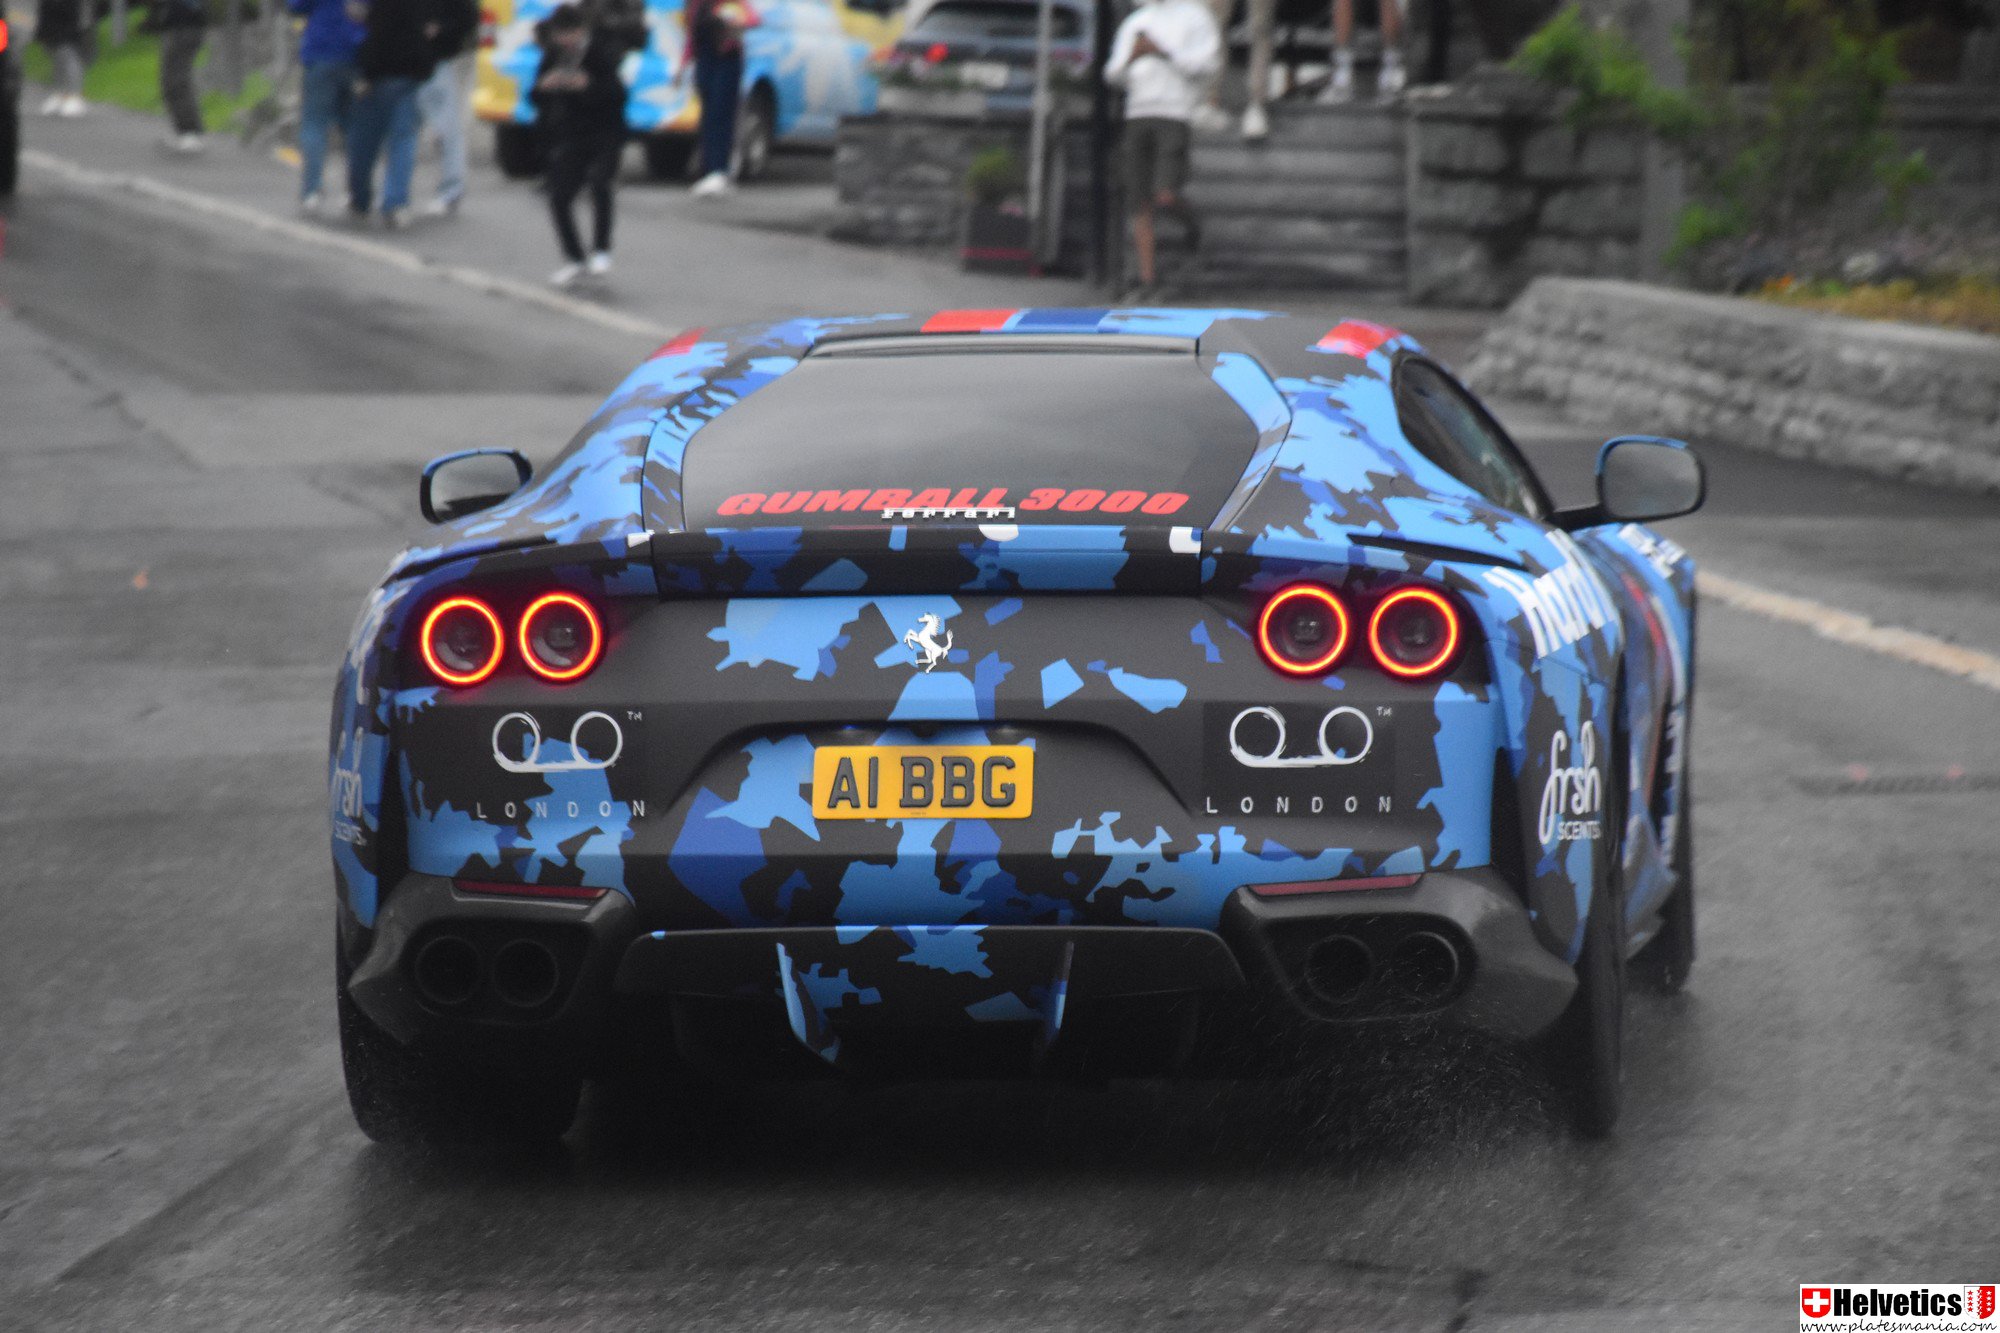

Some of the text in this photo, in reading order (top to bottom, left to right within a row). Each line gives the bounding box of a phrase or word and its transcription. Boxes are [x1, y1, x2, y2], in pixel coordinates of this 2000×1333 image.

[717, 487, 1190, 516] GUMBALL 3000
[900, 757, 1017, 809] BBG
[476, 801, 645, 820] LONDON
[1206, 796, 1391, 814] LONDON
